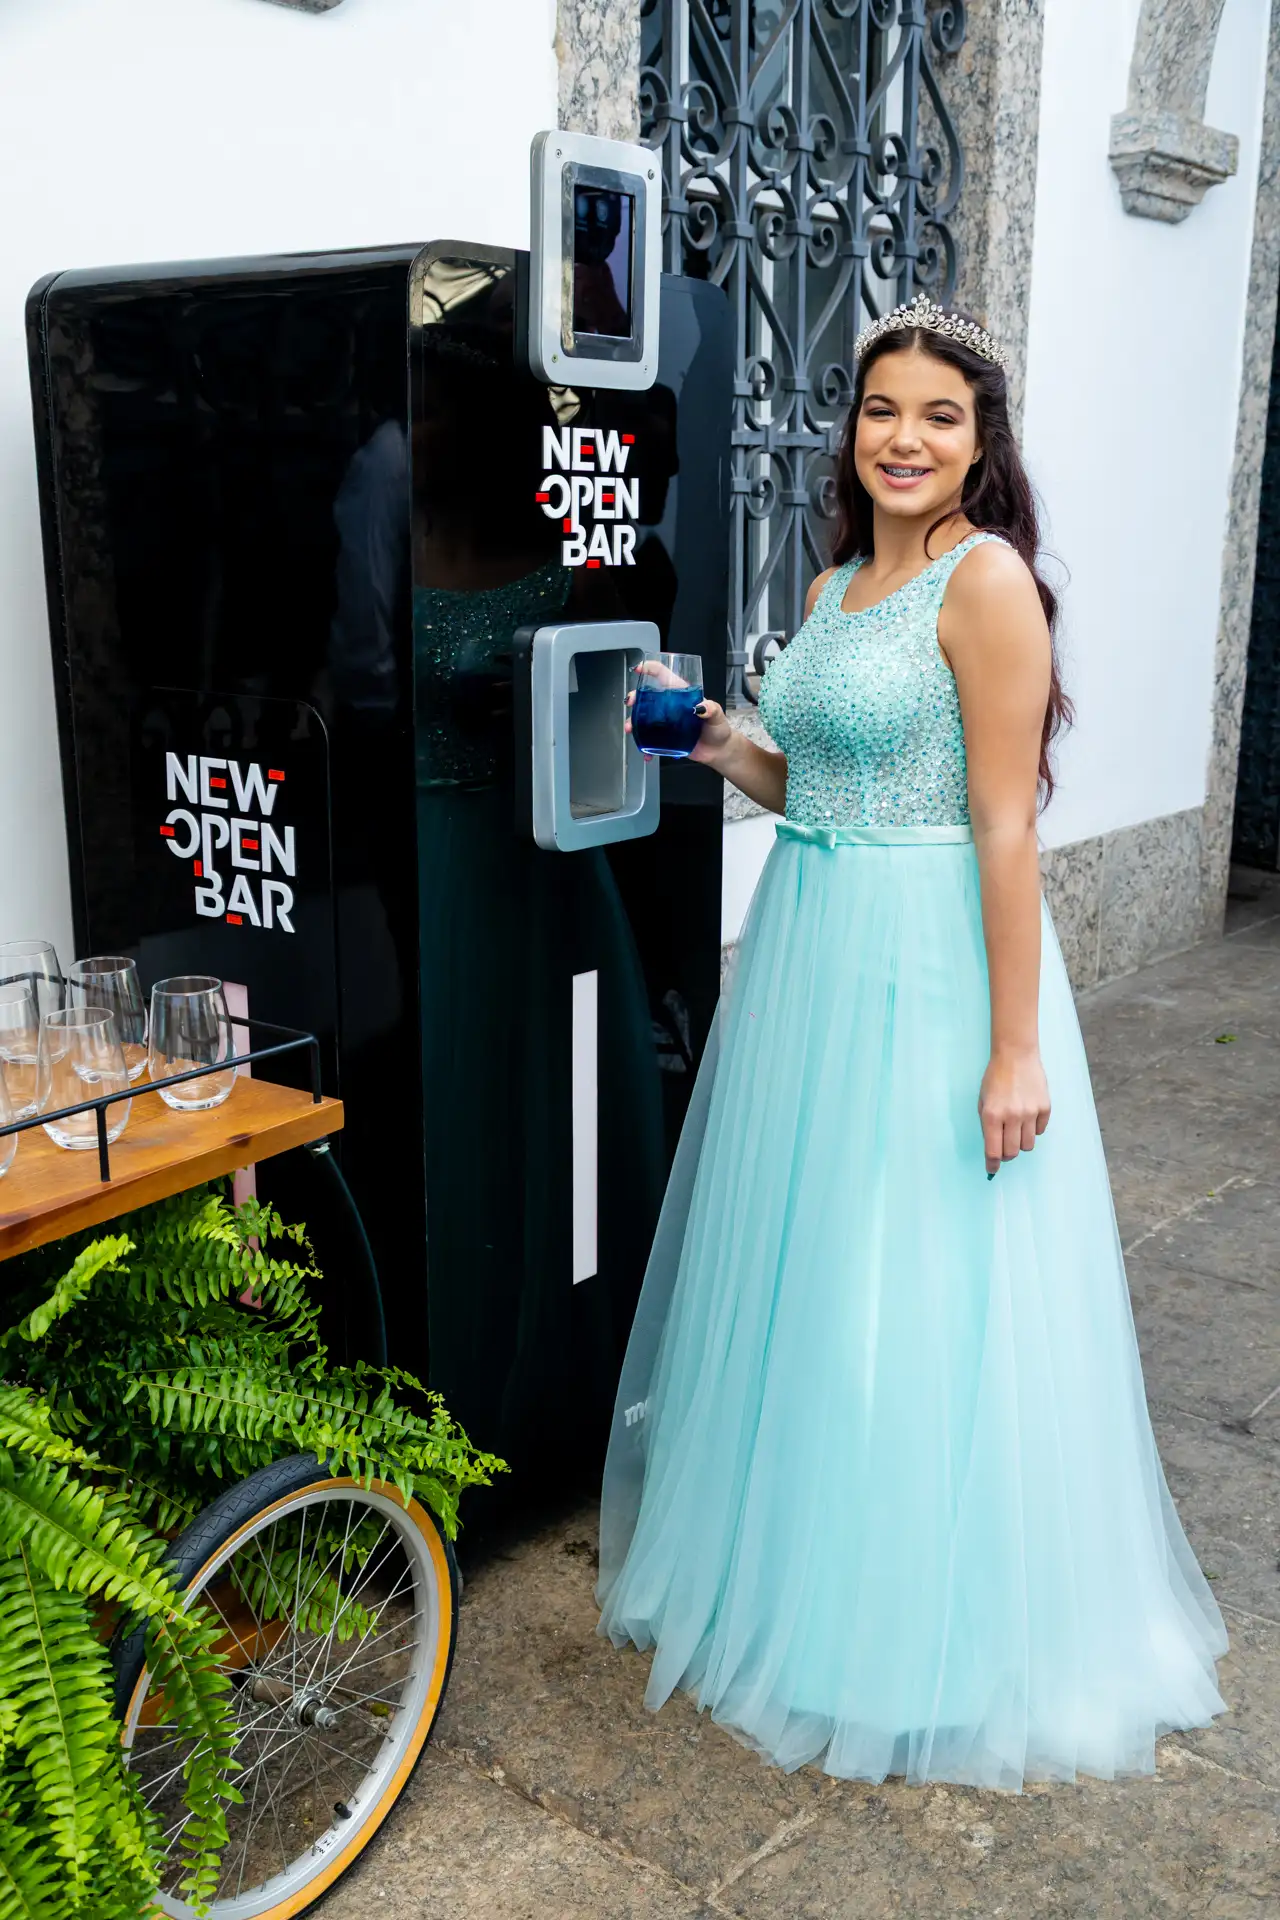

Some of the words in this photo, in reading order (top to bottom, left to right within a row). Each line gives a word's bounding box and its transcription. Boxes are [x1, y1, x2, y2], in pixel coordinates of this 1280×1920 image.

[542, 425, 635, 473] NEW
[535, 474, 640, 526] OPEN
[562, 523, 637, 569] BAR
[166, 751, 285, 816] NEW
[159, 808, 296, 877] OPEN
[194, 870, 296, 934] BAR
